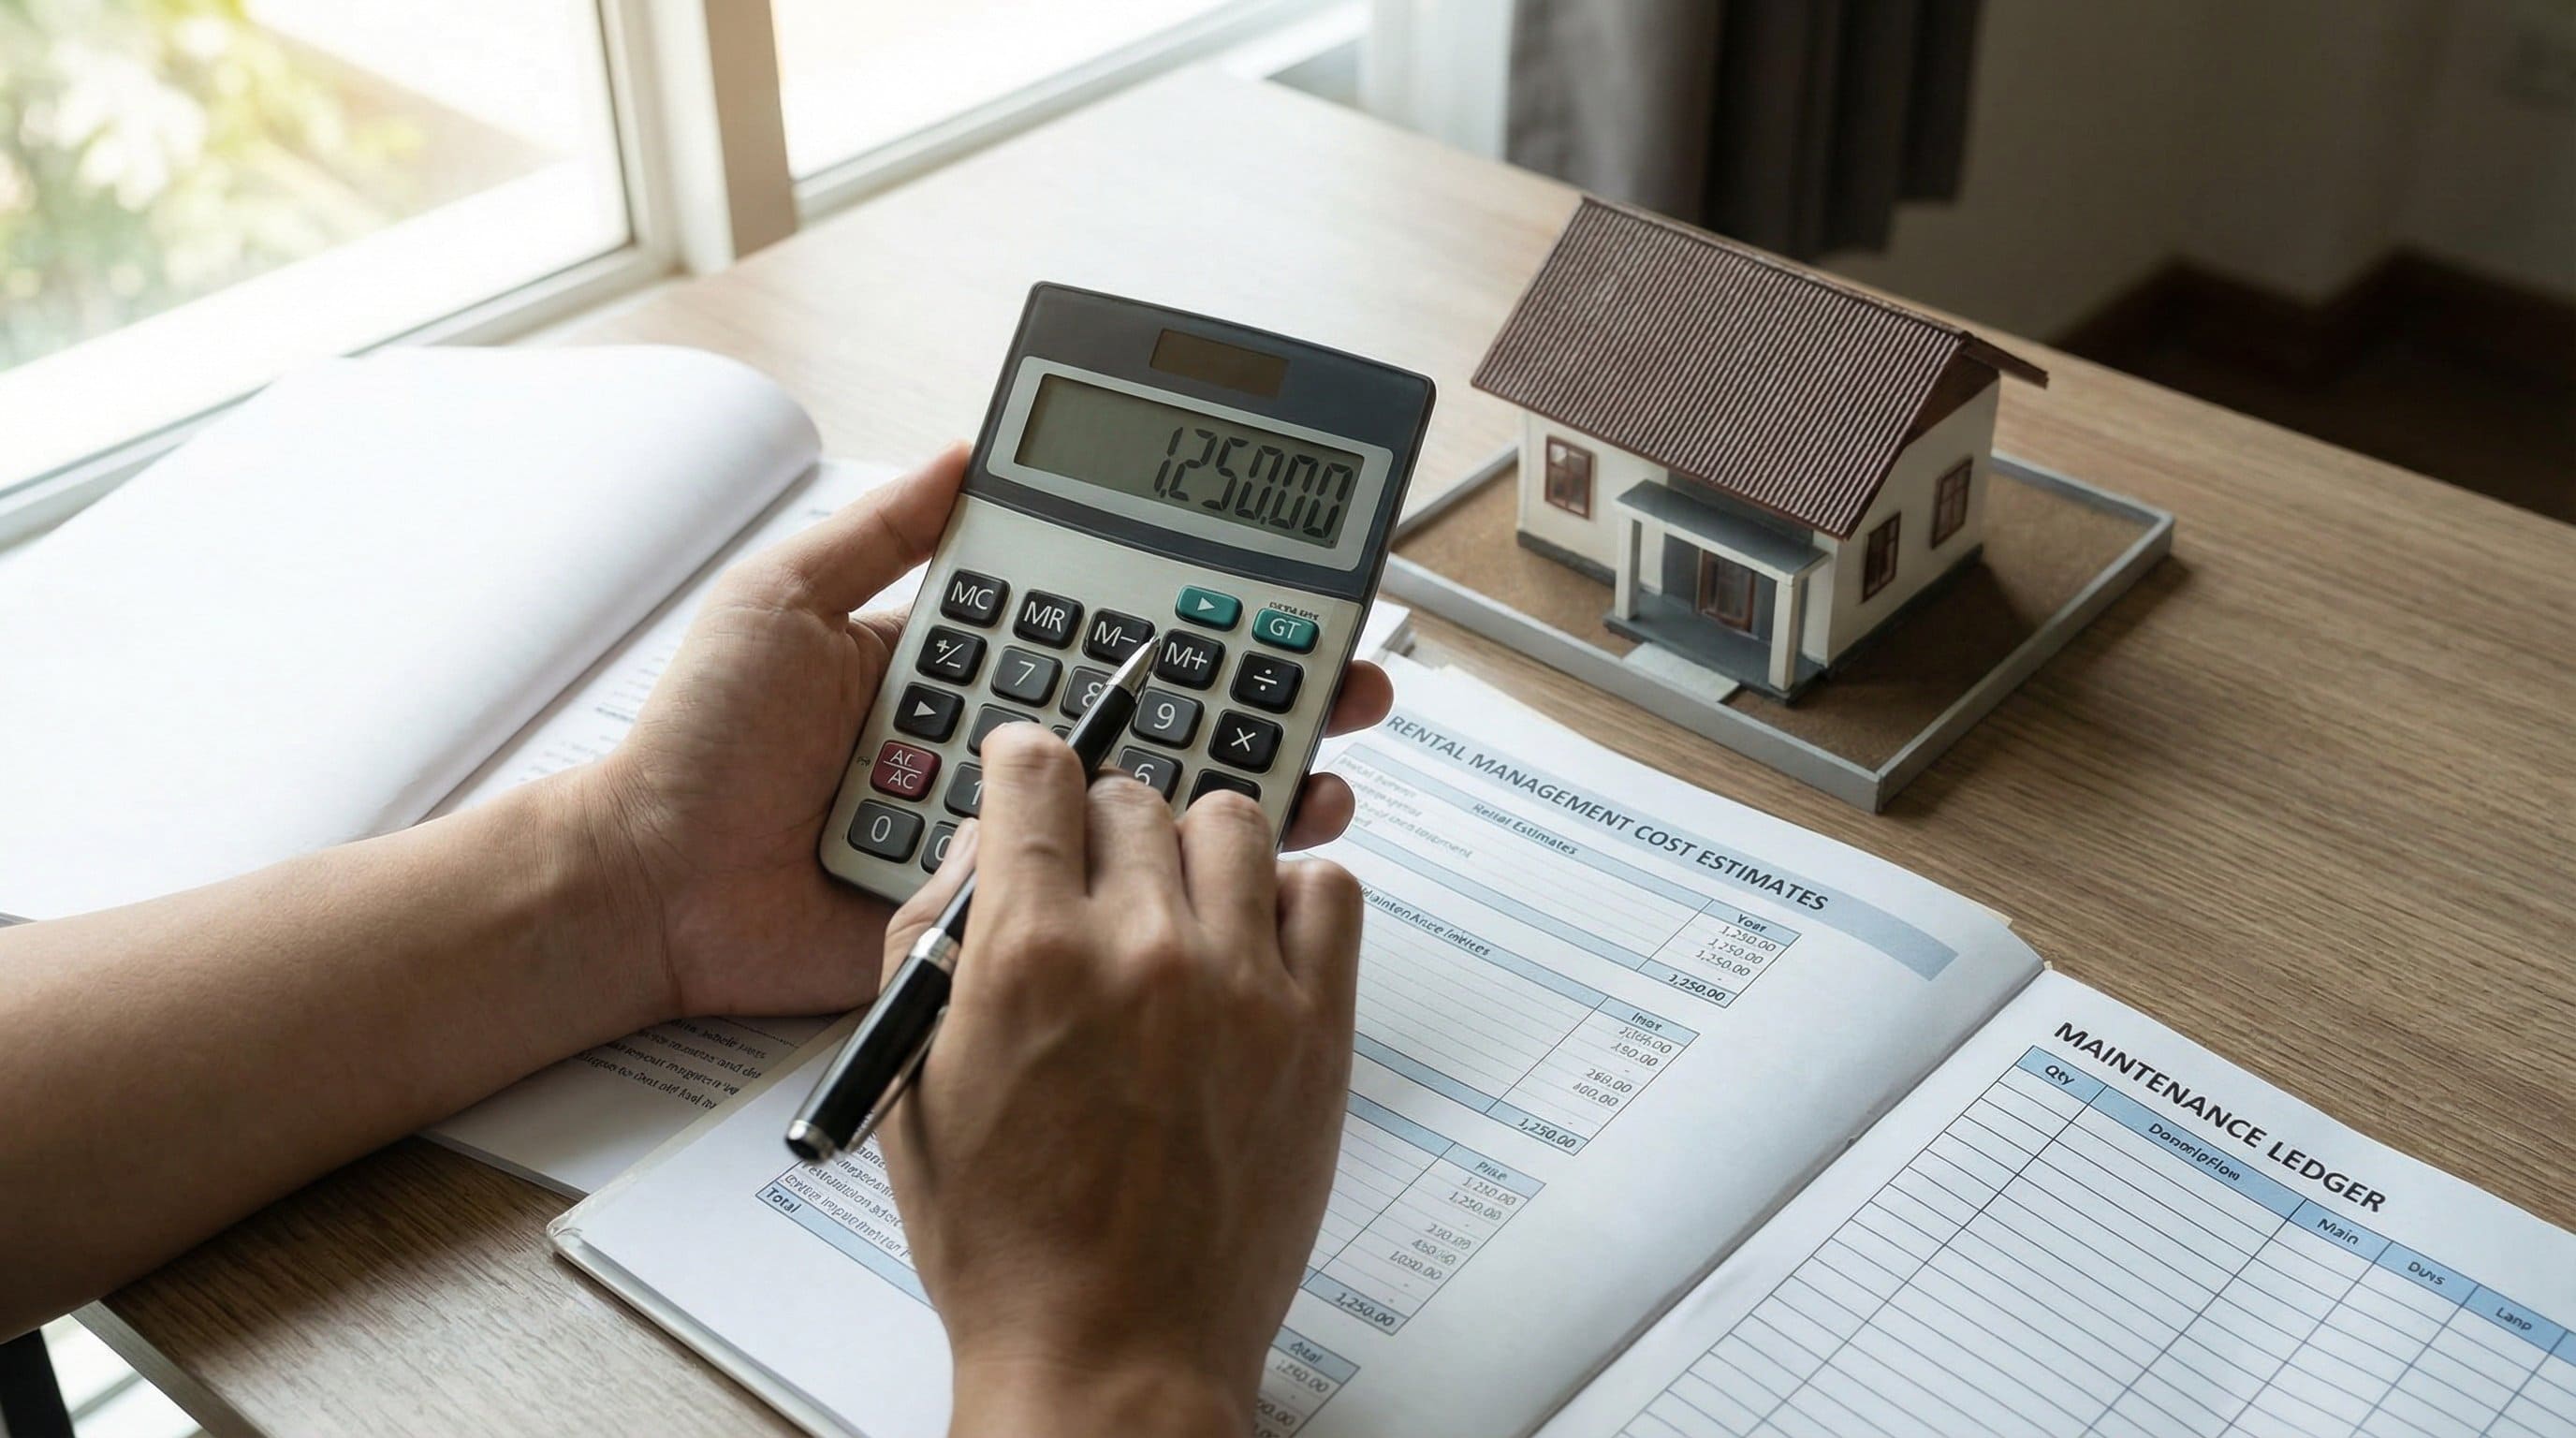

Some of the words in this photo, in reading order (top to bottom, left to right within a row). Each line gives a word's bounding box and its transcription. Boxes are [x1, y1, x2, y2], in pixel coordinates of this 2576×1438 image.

[950, 580, 994, 610] MC
[1024, 600, 1066, 633] MR
[1269, 617, 1302, 639] GT
[1164, 641, 1208, 670] M+
[1014, 660, 1036, 687] 7
[1153, 702, 1176, 730] 9
[886, 769, 918, 790] AC
[1385, 714, 1463, 761] RENTAL
[1468, 751, 1635, 832] MANAGEMENT
[1633, 824, 1698, 858] COST
[1695, 848, 1830, 913] ESTIMATES
[871, 814, 892, 844] 0
[2044, 1064, 2075, 1086] Qty
[2053, 1020, 2268, 1150] MAINTENANCE
[2266, 1139, 2387, 1214] LEDGER
